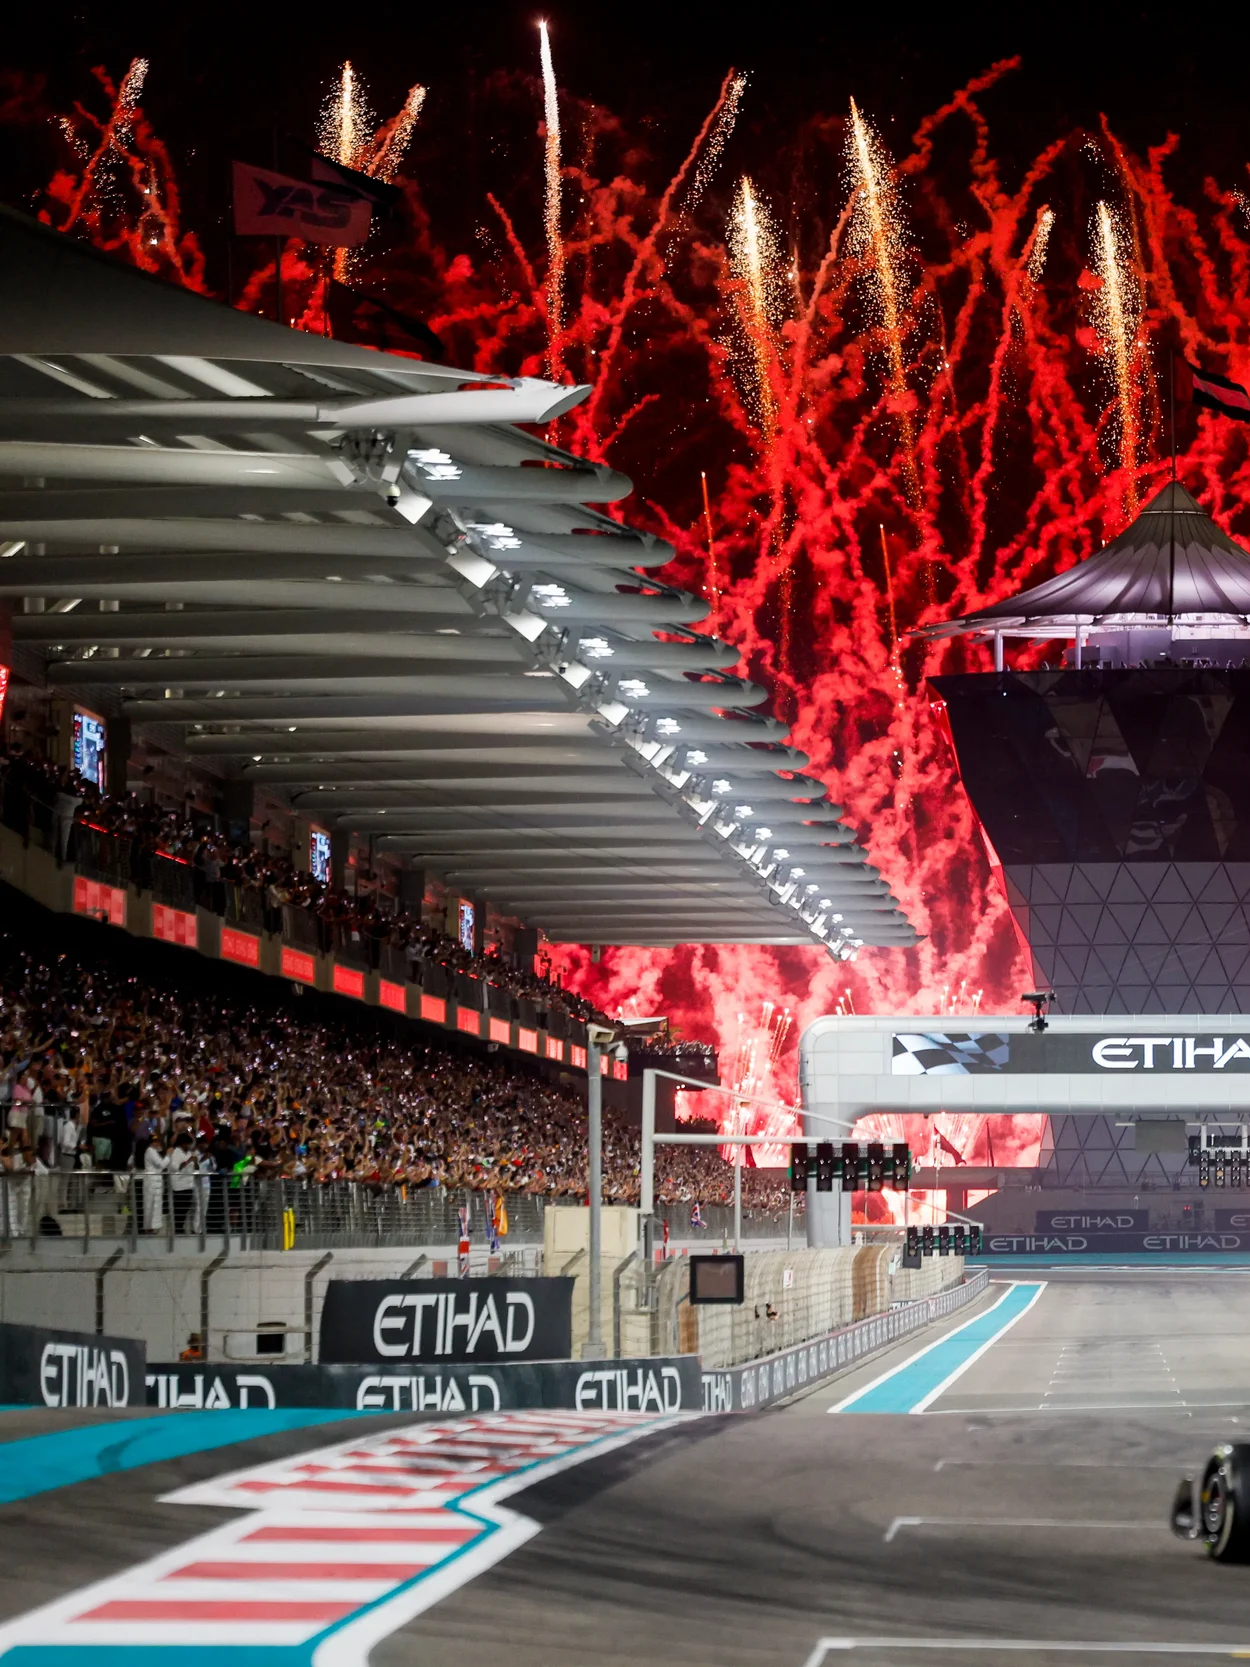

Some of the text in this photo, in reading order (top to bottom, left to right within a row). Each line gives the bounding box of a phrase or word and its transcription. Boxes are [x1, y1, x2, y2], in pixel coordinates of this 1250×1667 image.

[1050, 1216, 1135, 1229] ETIHAD
[989, 1236, 1088, 1252] ETIHAD
[1143, 1235, 1241, 1250] ETIHAD
[373, 1292, 535, 1357] ETIHAD
[40, 1343, 129, 1408] ETIHAD
[145, 1374, 276, 1410] IHAD
[356, 1374, 500, 1412] ETIHAD
[575, 1366, 682, 1415] ETIHAD
[702, 1373, 732, 1412] TIHAD
